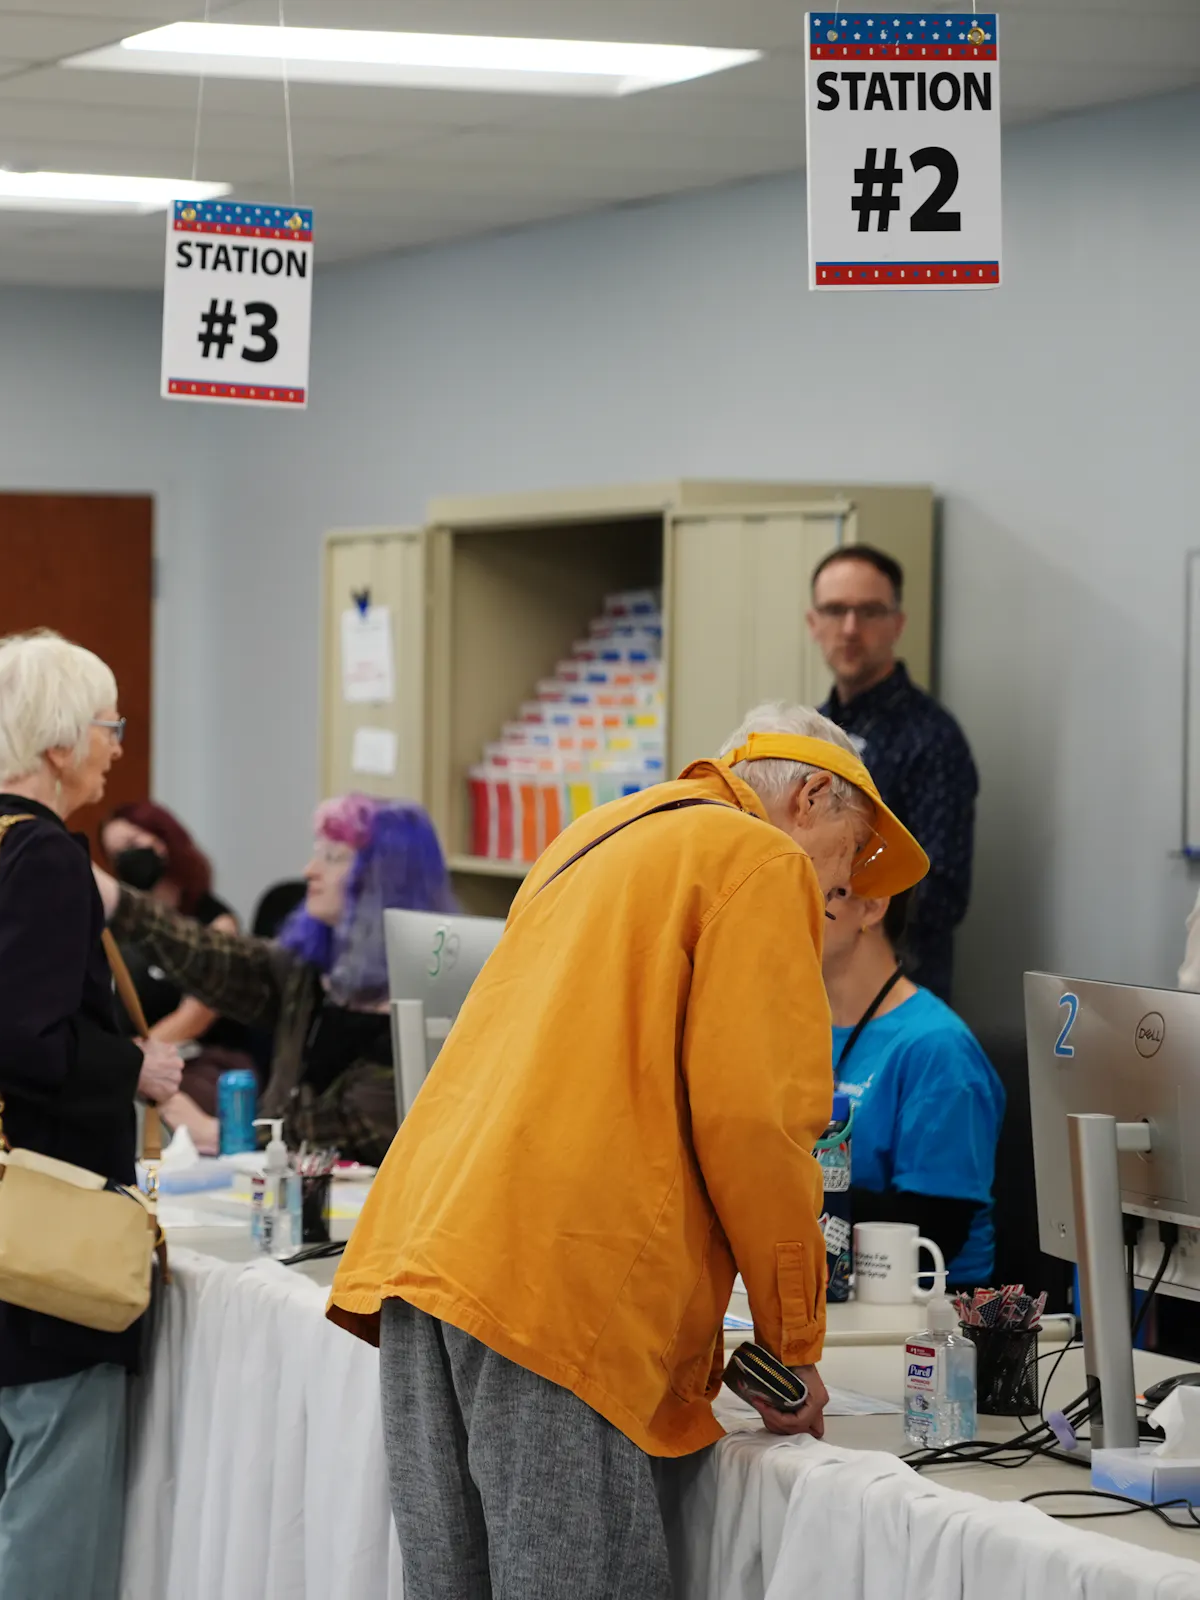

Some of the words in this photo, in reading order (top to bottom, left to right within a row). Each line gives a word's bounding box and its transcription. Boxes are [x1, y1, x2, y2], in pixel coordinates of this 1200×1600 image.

[816, 71, 992, 111] STATION
[851, 146, 961, 232] #2
[176, 240, 308, 278] STATION
[197, 297, 279, 363] #3
[1054, 992, 1079, 1057] 2
[1138, 1027, 1161, 1042] DELL
